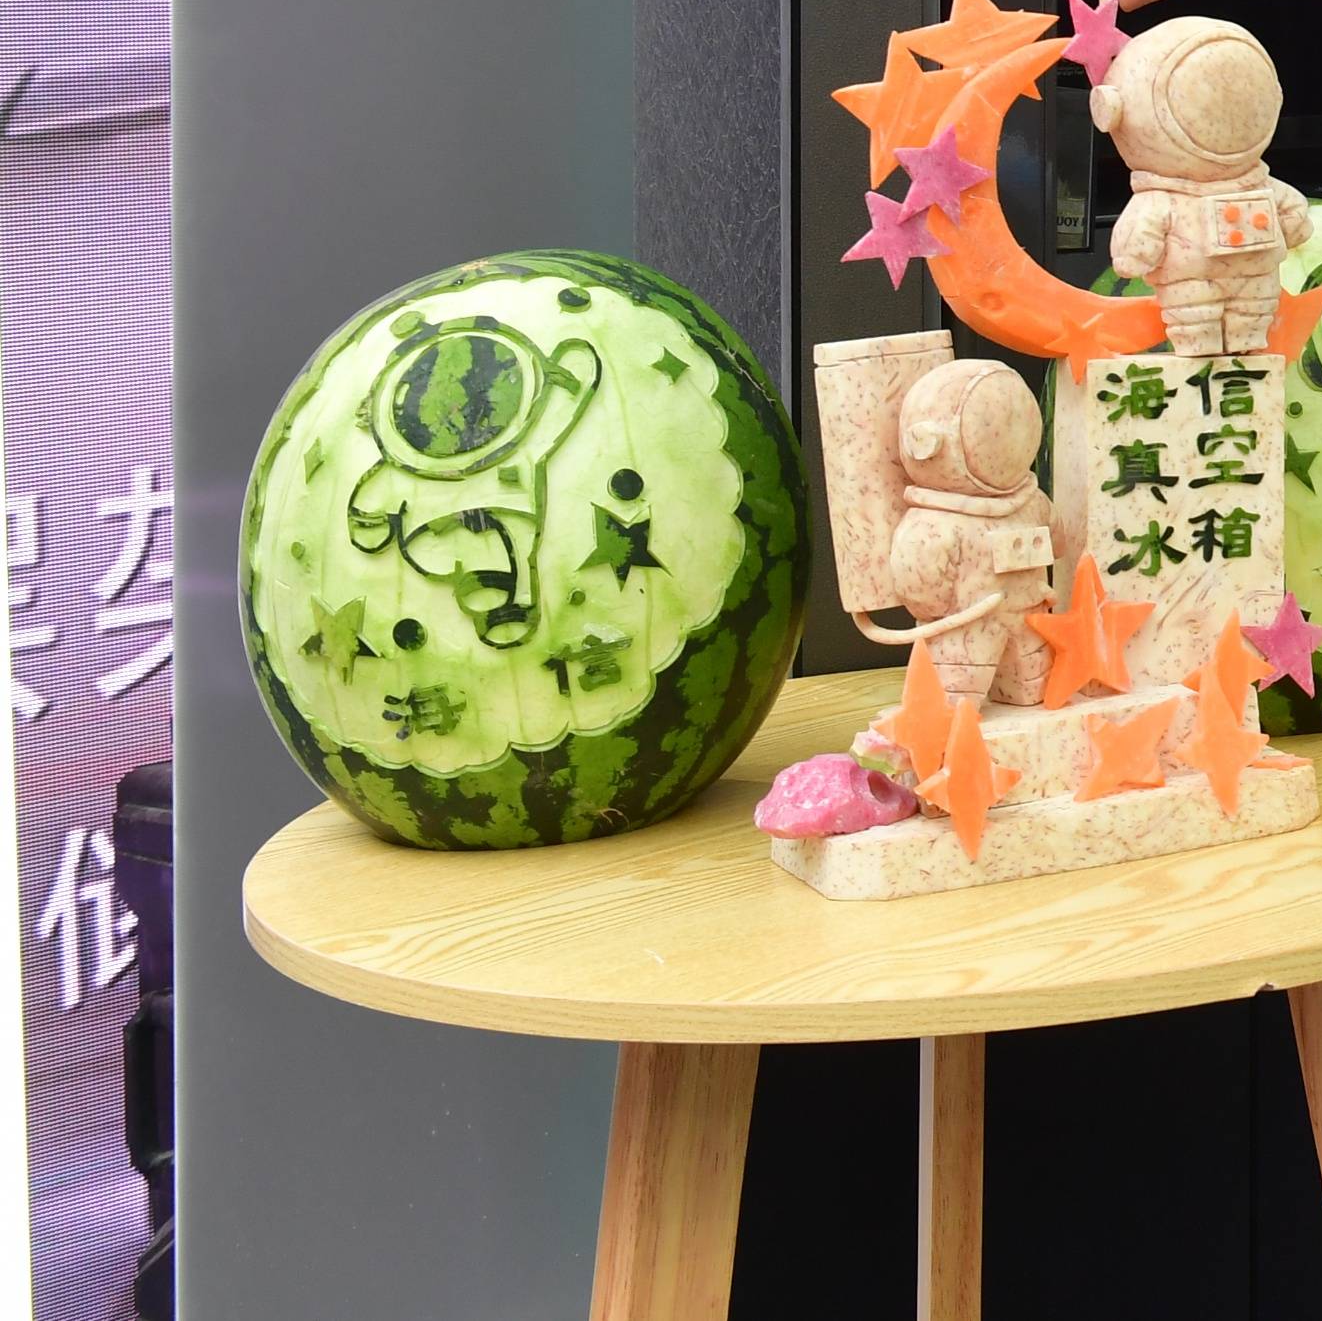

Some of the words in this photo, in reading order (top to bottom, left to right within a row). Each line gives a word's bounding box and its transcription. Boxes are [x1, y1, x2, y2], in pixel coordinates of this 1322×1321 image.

[1096, 358, 1271, 422] 海信
[1101, 423, 1265, 505] 真空
[1107, 507, 1262, 577] 冰箱
